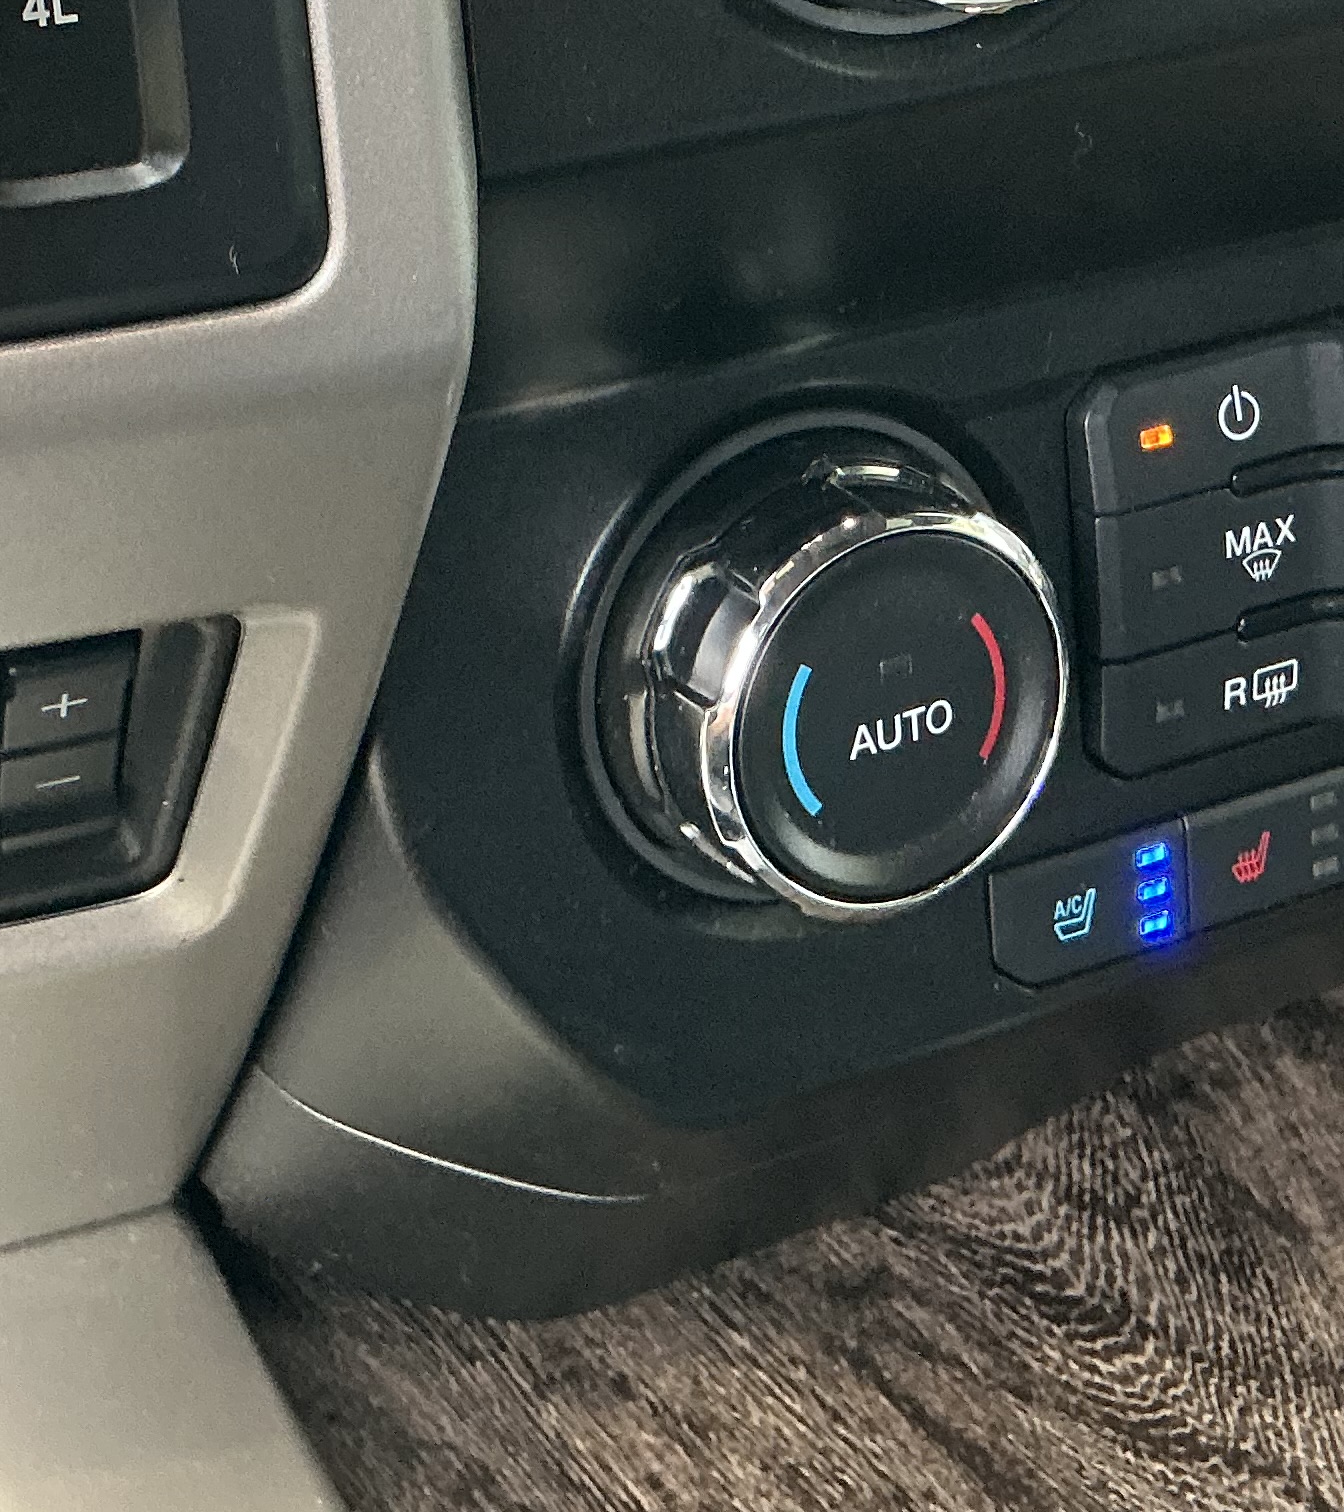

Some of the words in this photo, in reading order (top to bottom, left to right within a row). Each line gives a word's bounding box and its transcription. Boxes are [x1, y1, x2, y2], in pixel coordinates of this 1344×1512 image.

[1224, 514, 1296, 560] MAX
[1223, 675, 1247, 710] R
[849, 698, 954, 761] AUTO
[1054, 895, 1082, 920] A/C
